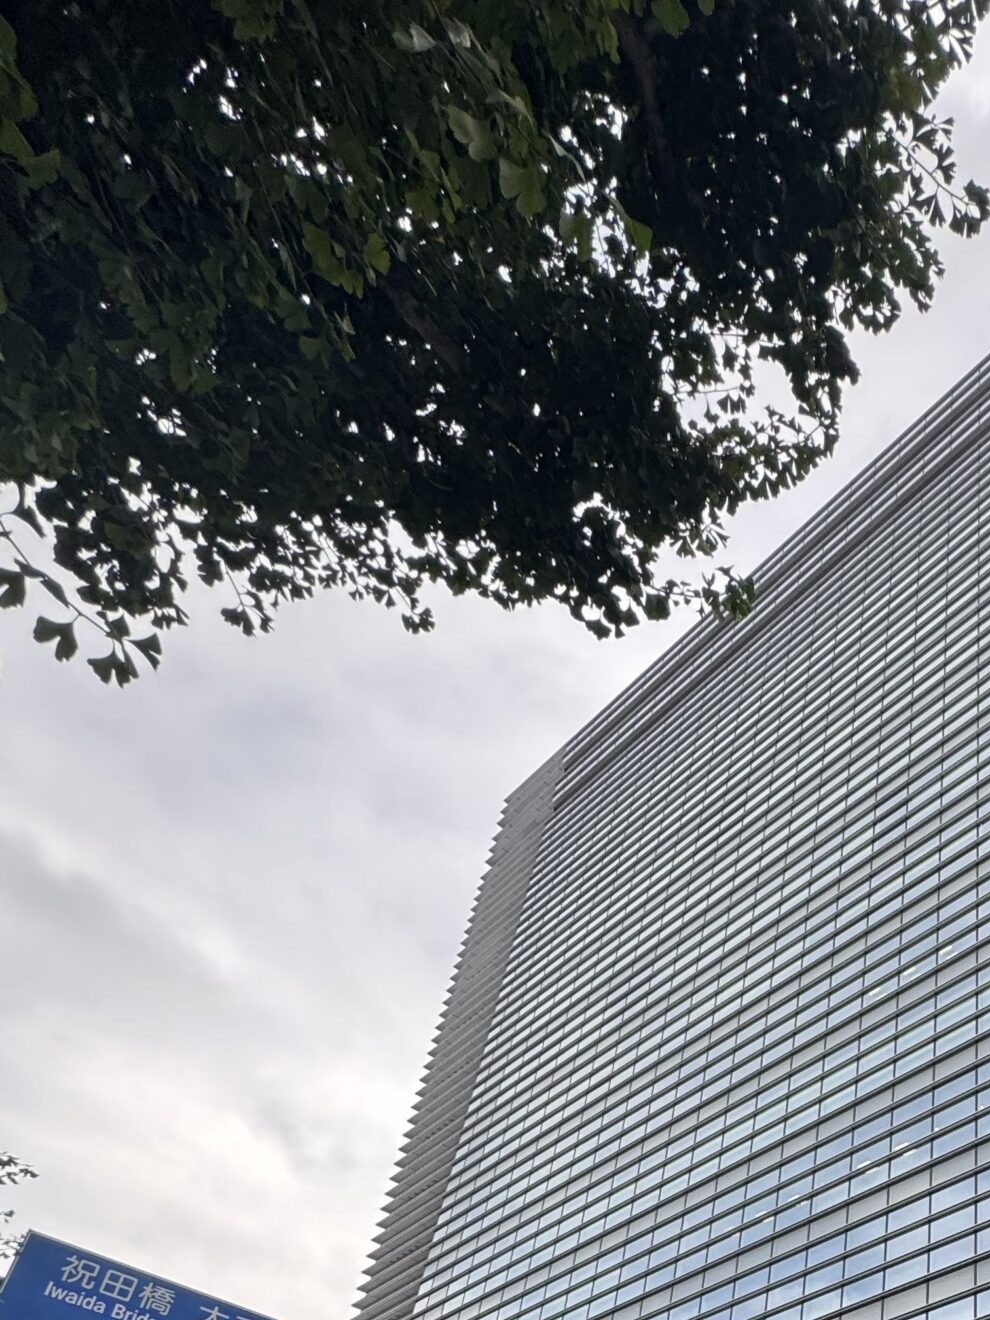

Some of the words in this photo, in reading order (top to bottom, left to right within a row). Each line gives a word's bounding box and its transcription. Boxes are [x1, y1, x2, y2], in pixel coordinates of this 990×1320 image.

[43, 1280, 107, 1314] Iwaida
[60, 1254, 177, 1316] 祝田橋
